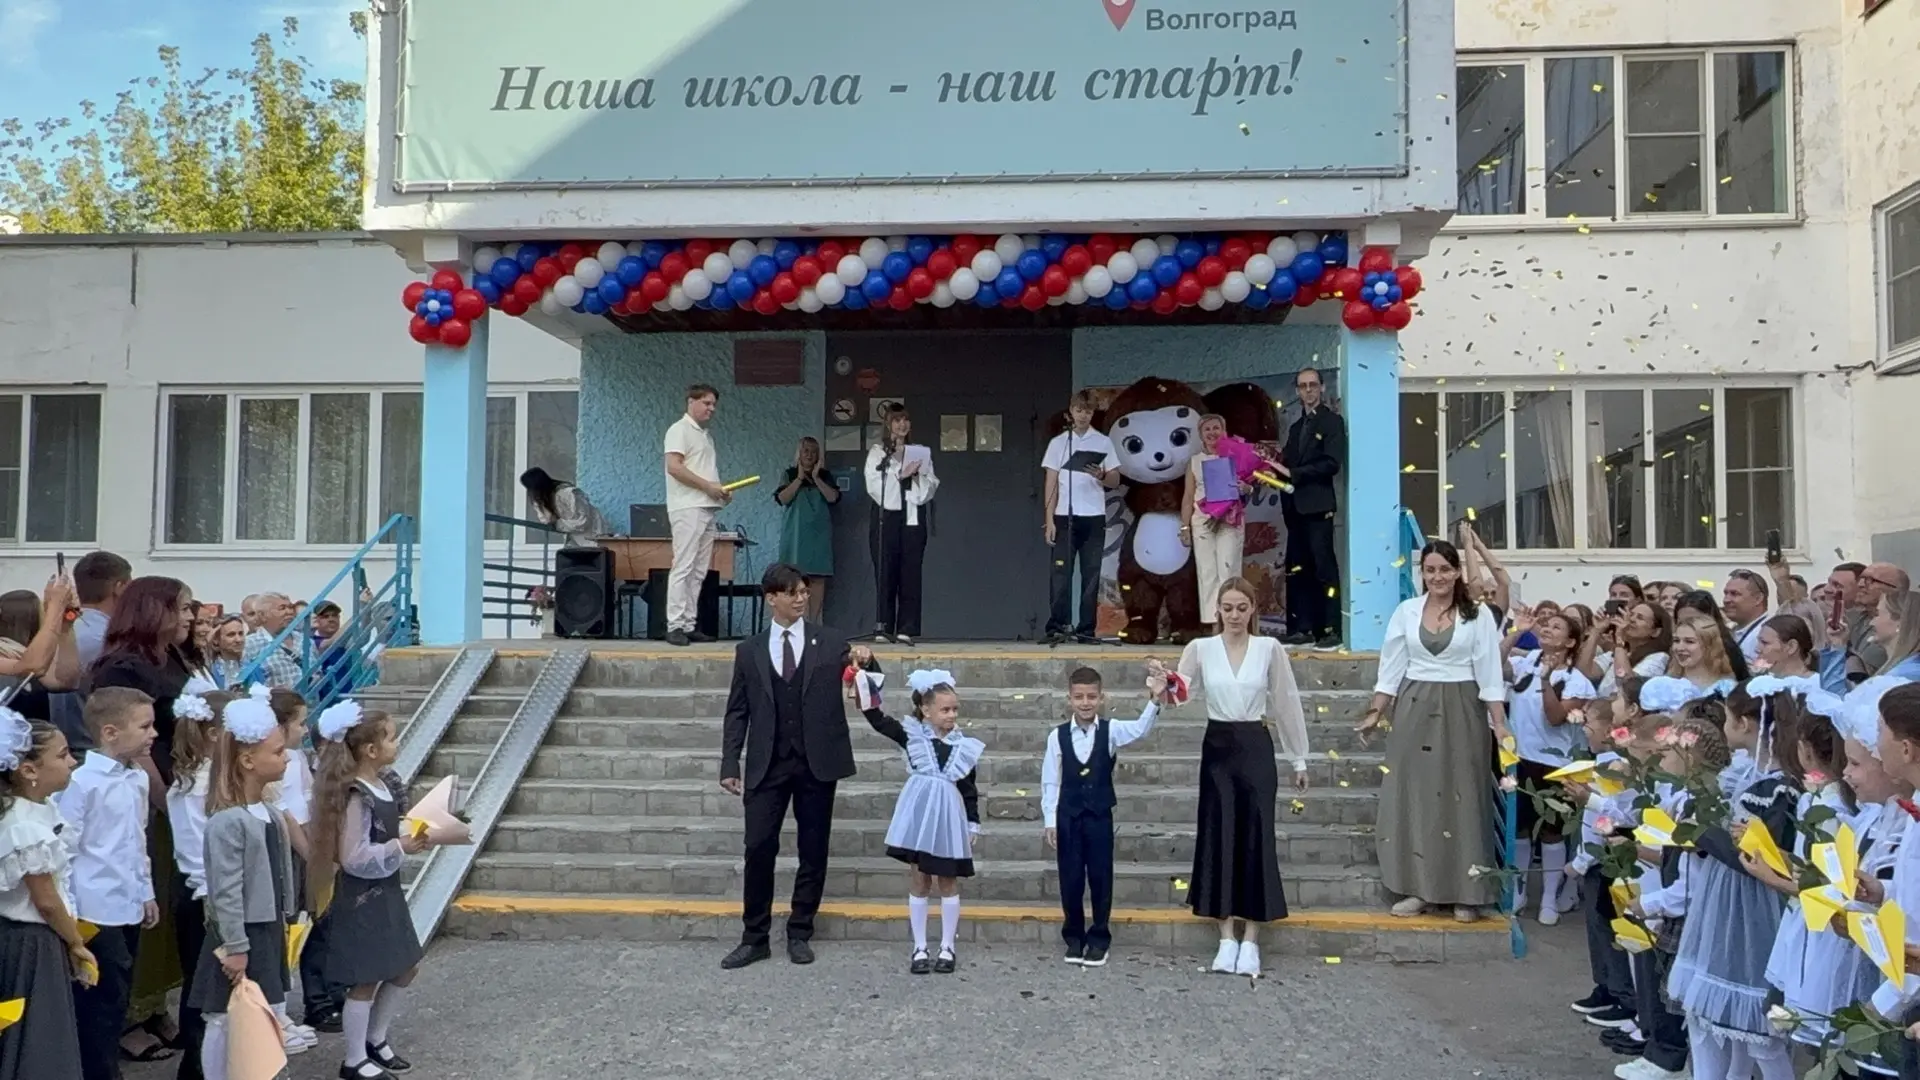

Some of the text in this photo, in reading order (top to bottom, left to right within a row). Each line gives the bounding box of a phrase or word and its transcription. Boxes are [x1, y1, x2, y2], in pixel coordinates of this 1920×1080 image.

[1146, 8, 1297, 33] Волгоград
[490, 66, 656, 111] Наша
[683, 73, 863, 108] школа
[937, 68, 1057, 102] наш
[1084, 48, 1303, 116] старт!
